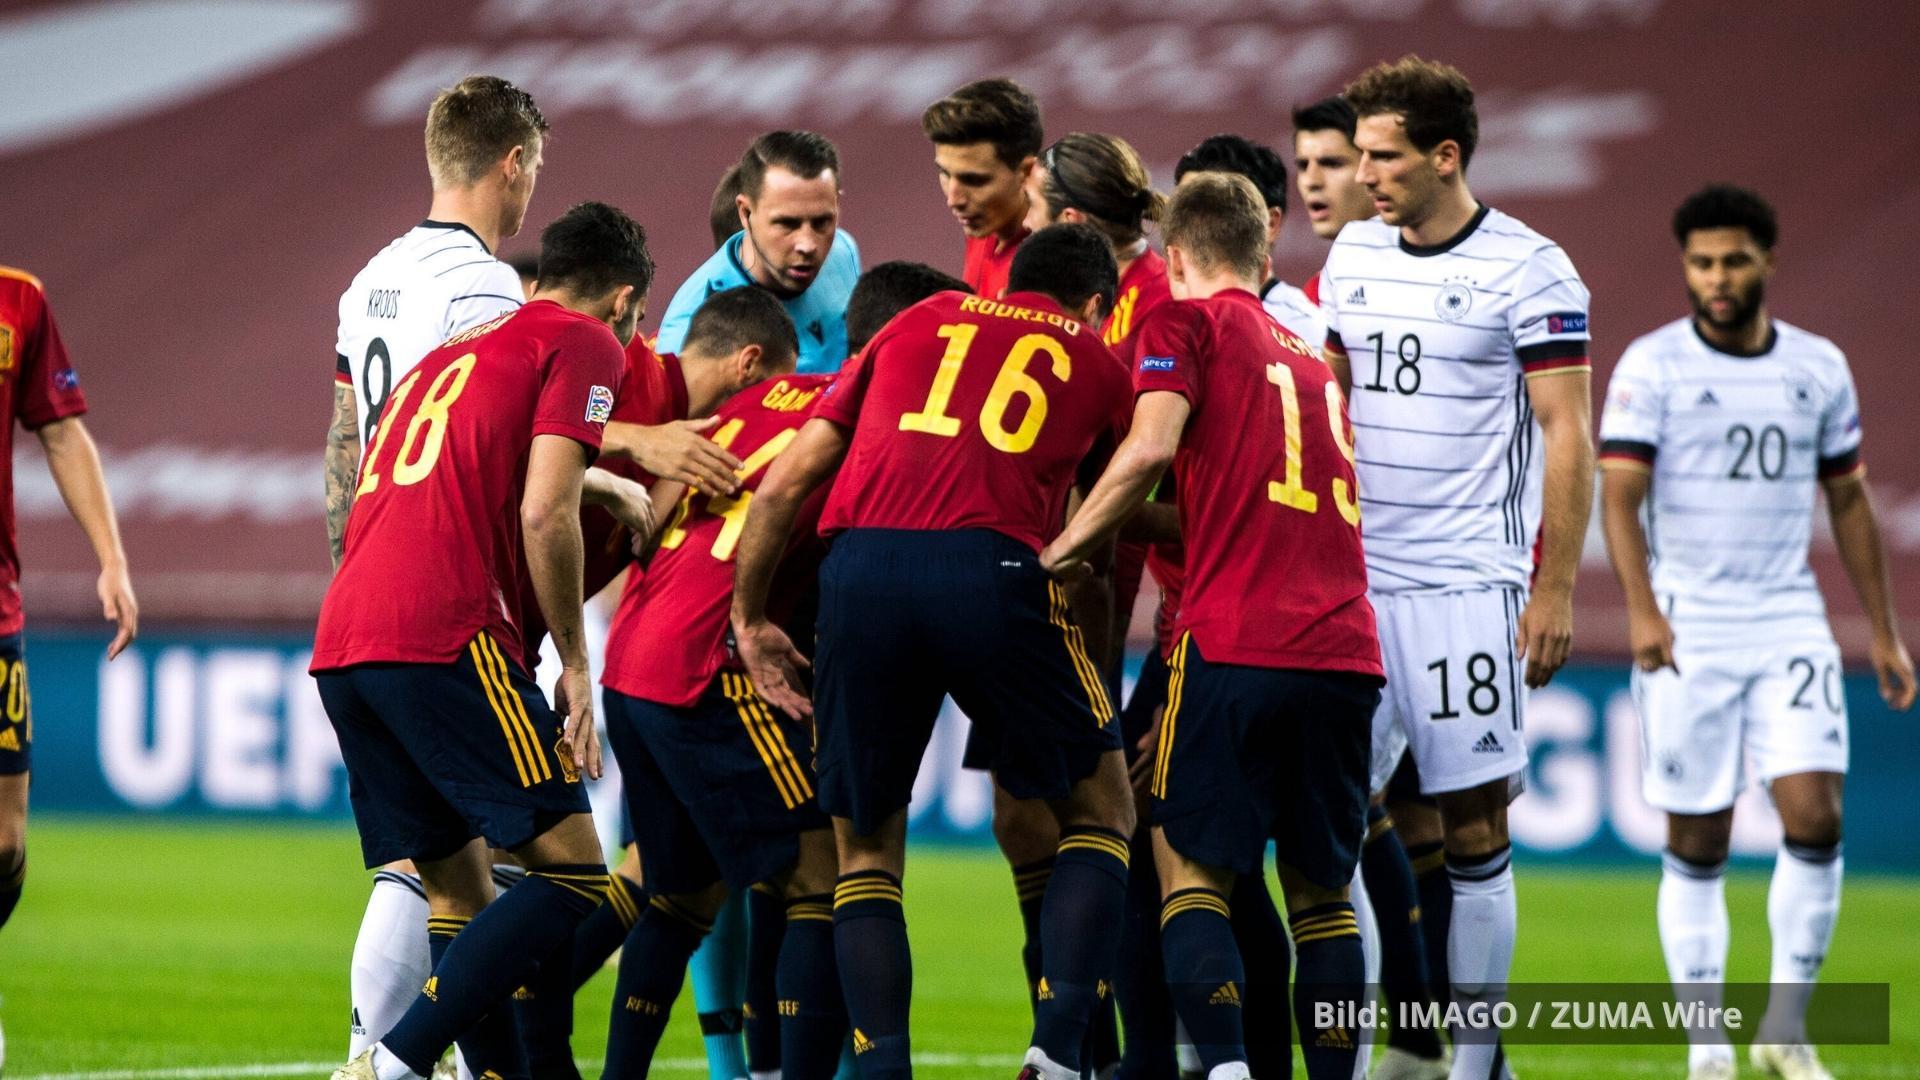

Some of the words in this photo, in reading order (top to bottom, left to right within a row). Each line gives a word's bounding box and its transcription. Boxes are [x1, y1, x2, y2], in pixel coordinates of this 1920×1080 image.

[366, 288, 401, 319] KROOS
[960, 295, 1081, 337] RODRIGO
[898, 323, 1072, 454] 16
[1363, 331, 1422, 395] 18
[355, 352, 477, 502] 18
[1266, 361, 1361, 528] 19
[1726, 423, 1787, 481] 20
[1427, 651, 1500, 720] 18
[1787, 656, 1842, 717] 20
